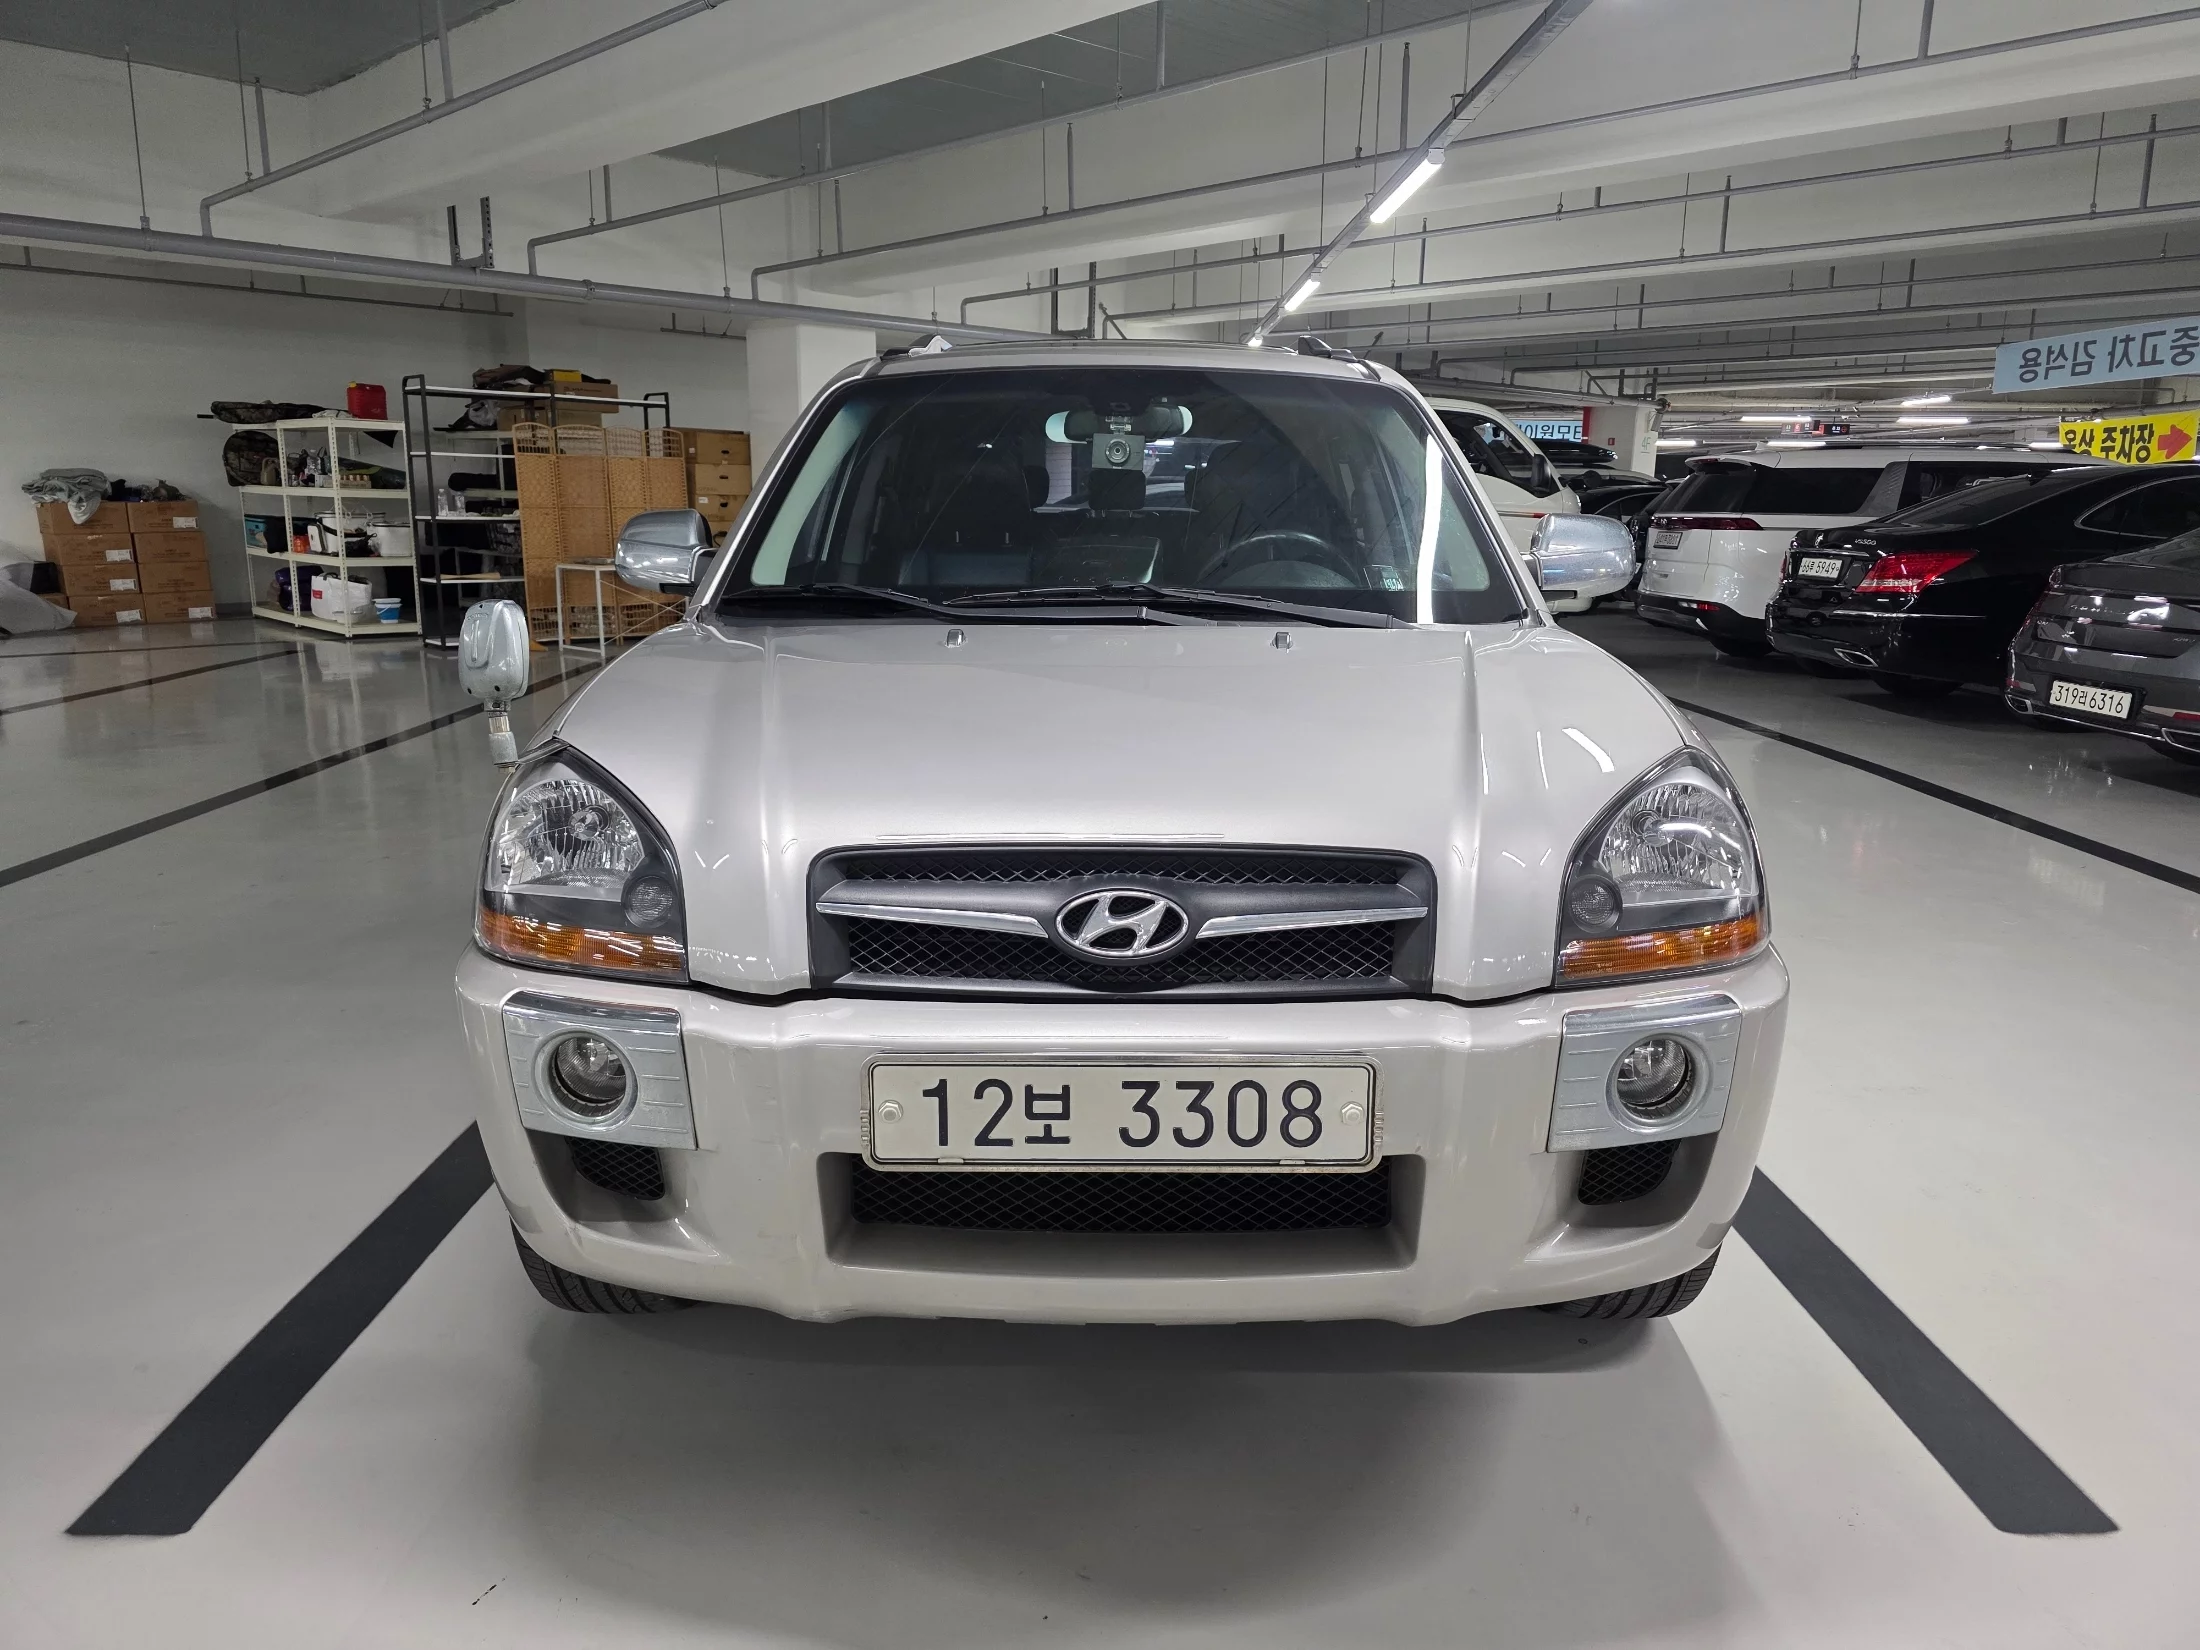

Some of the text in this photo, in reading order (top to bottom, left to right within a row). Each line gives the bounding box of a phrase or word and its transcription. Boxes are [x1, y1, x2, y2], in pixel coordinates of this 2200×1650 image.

[2099, 422, 2155, 464] 주차장
[1815, 560, 1837, 576] 5949
[921, 1078, 1324, 1149] 12보 3308
